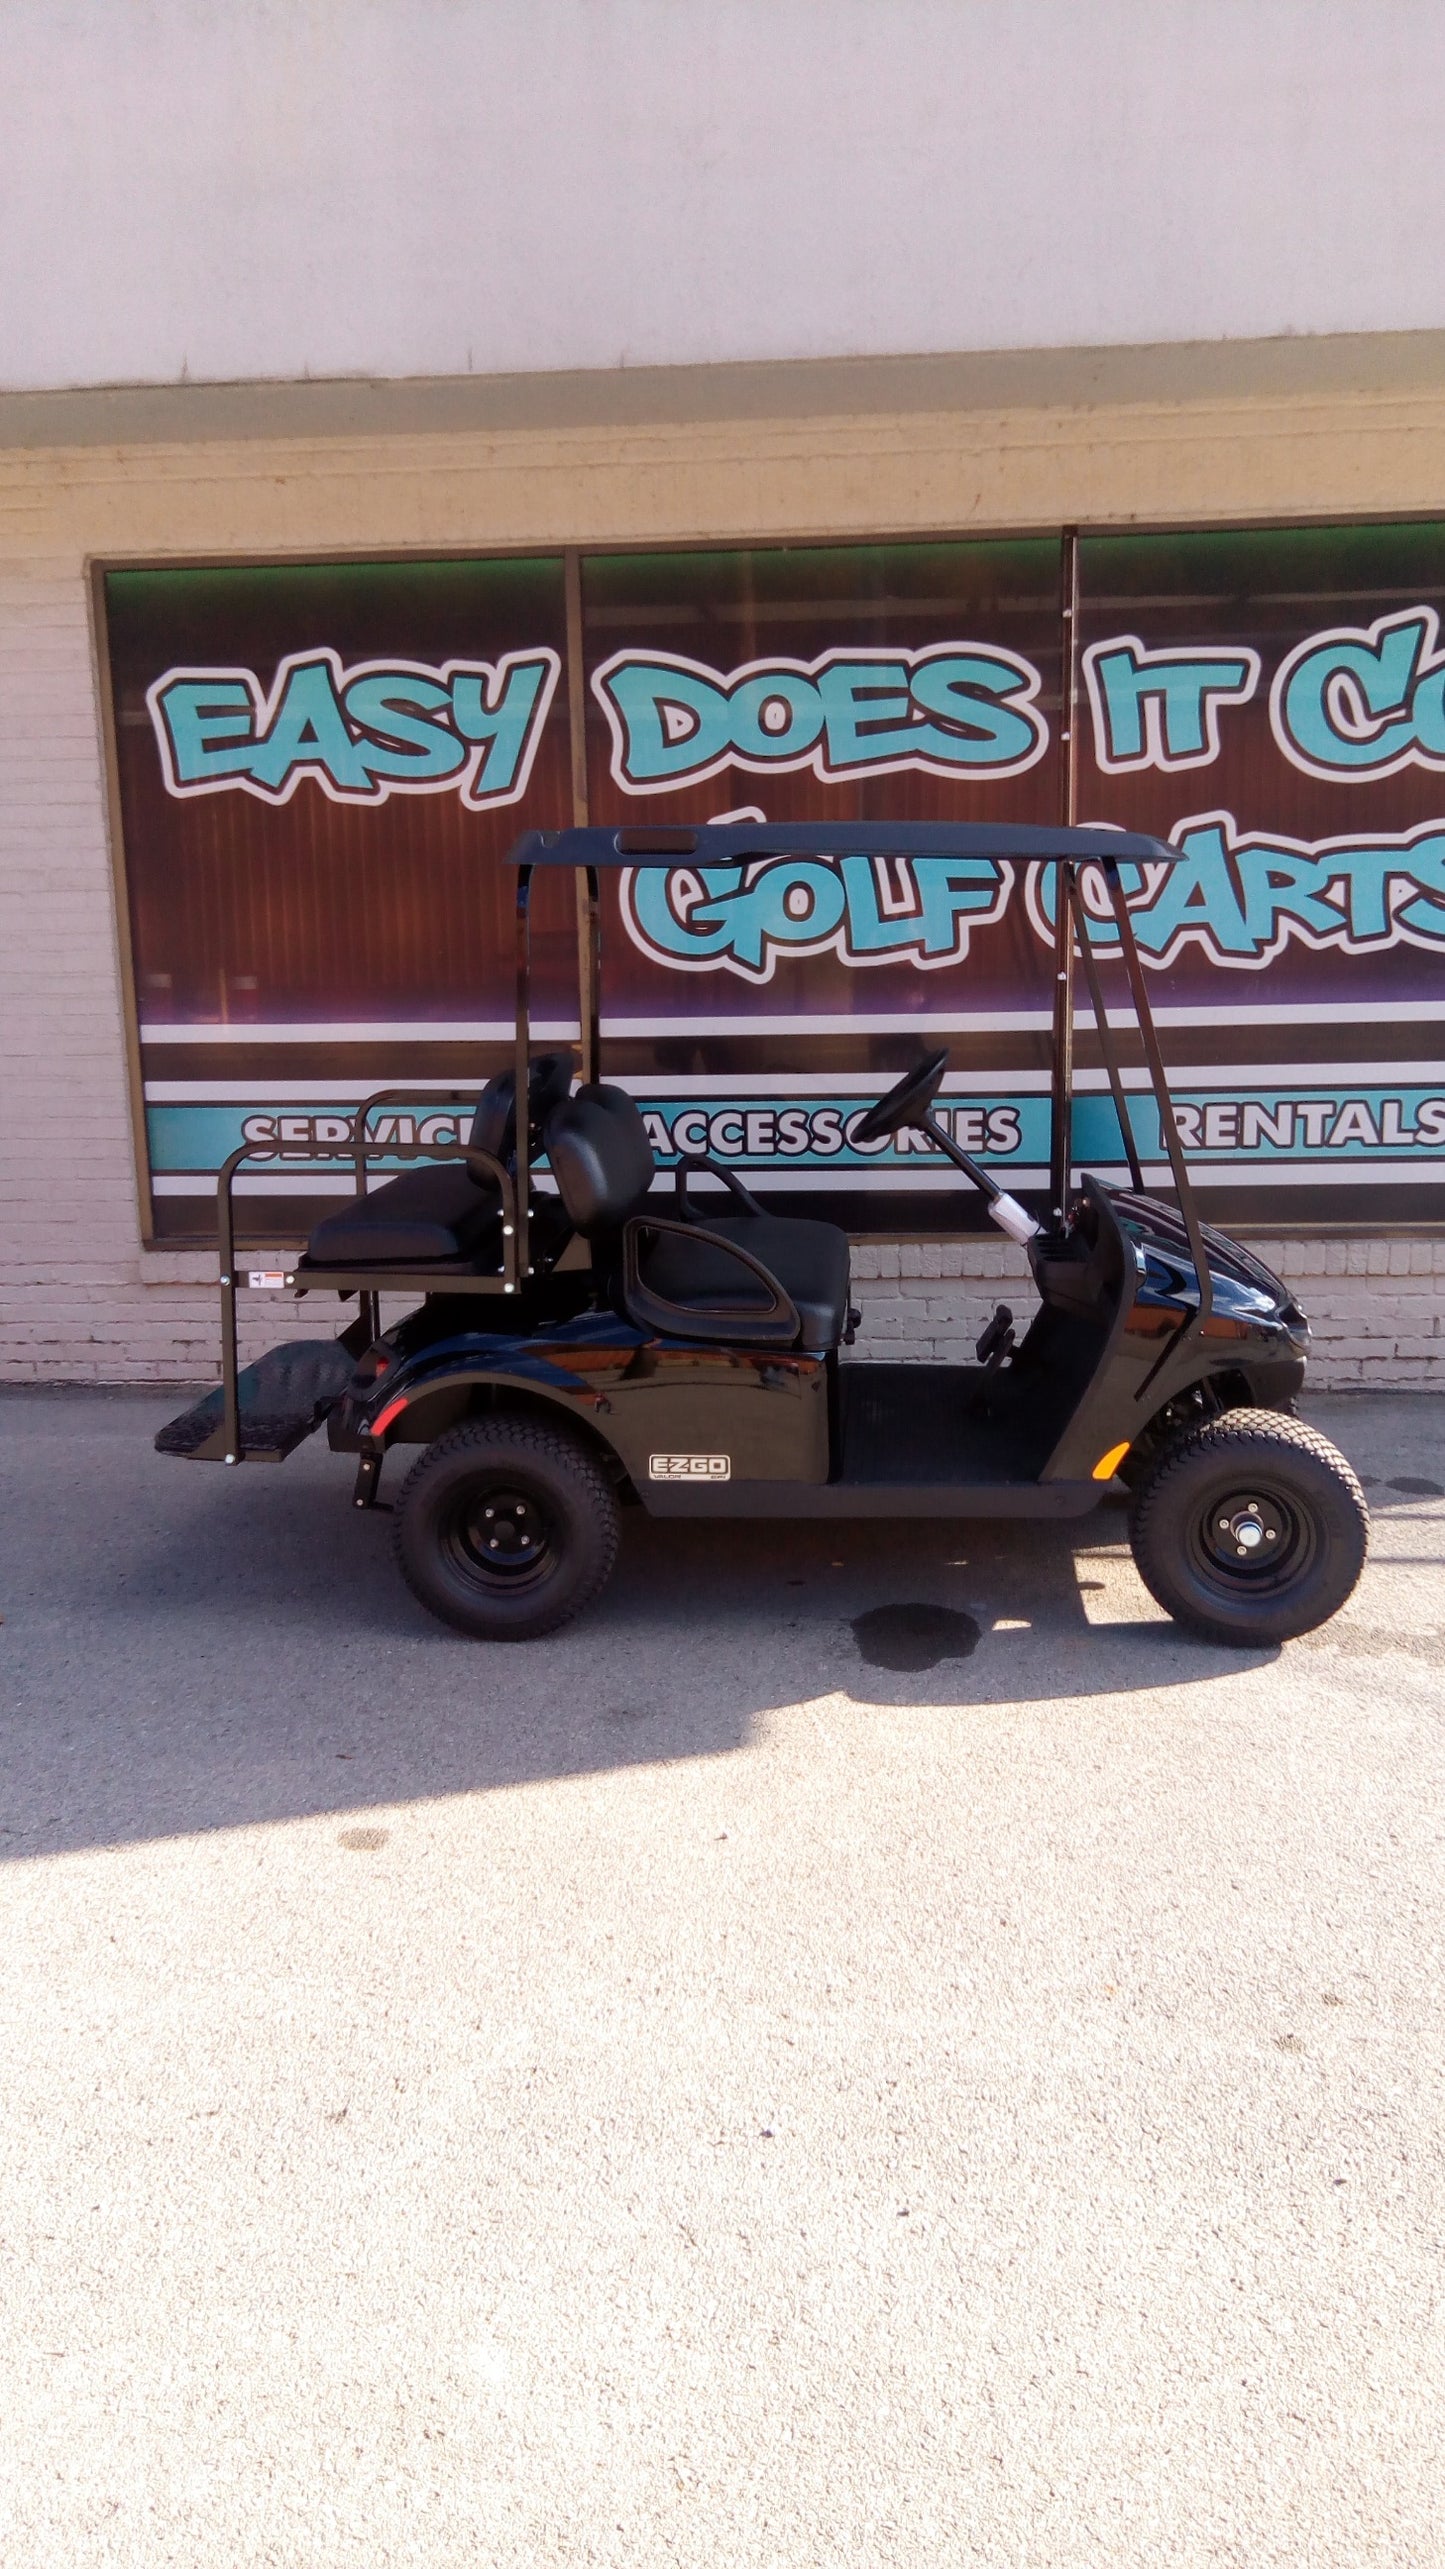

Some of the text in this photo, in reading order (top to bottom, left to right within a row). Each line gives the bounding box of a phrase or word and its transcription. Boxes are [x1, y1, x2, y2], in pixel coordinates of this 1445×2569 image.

[152, 653, 556, 804] EASY
[596, 646, 1044, 790] DOES
[1088, 642, 1258, 768] IT
[624, 814, 1445, 978] GOLF CARTS
[243, 1115, 475, 1158] SERVIC
[1162, 1099, 1445, 1148] RENTALS
